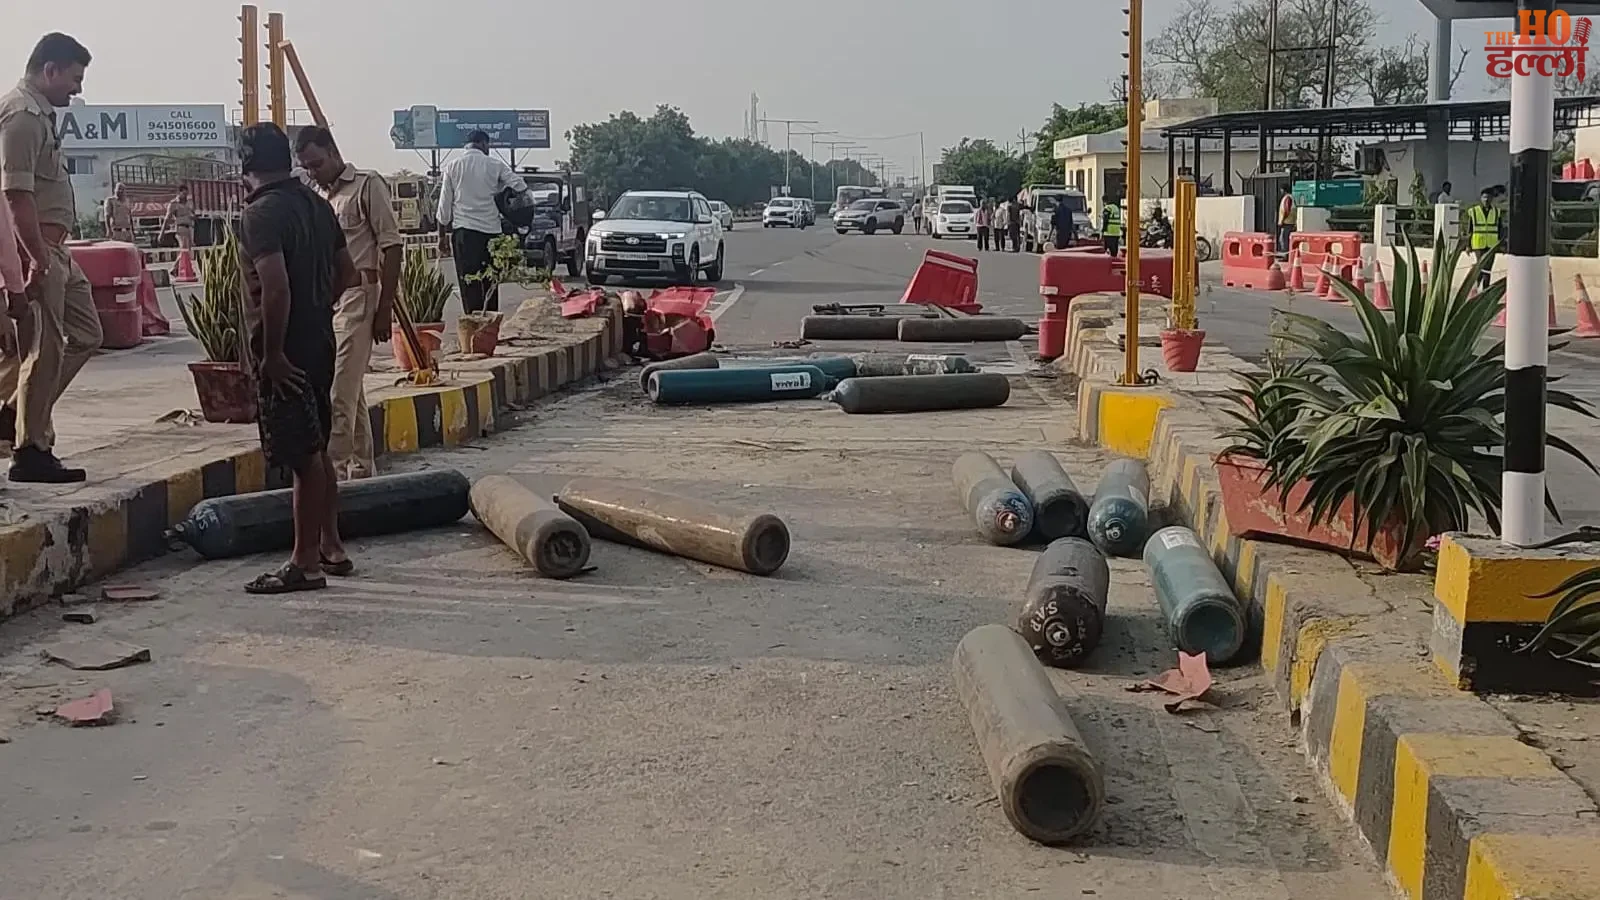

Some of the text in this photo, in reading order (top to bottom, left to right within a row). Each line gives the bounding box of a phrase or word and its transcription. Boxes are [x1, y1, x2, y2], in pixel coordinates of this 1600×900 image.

[170, 111, 193, 119] CALL
[60, 112, 127, 140] A&M
[148, 121, 216, 130] 9415016600
[147, 132, 218, 141] 9336590720
